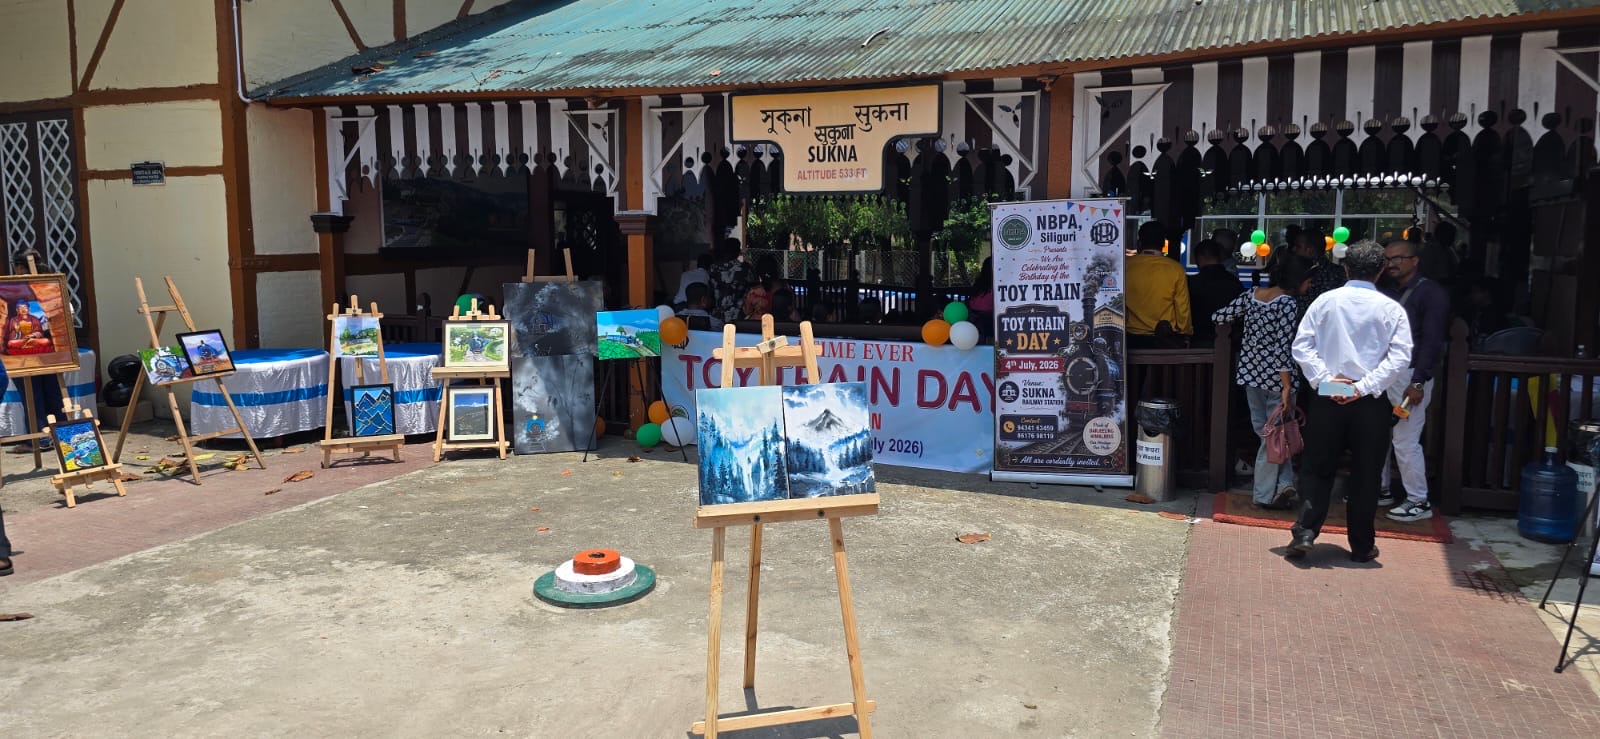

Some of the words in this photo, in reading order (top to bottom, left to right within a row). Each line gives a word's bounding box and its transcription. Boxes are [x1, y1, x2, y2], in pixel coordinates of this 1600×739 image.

[853, 103, 909, 132] सुकना
[808, 145, 858, 163] SUKNA
[797, 169, 837, 180] ALTITUDE
[839, 168, 854, 178] 533
[1036, 214, 1083, 231] NBPA,
[1040, 231, 1076, 244] Siliguri
[1043, 245, 1068, 253] Presents
[1021, 263, 1058, 273] Celebrating
[1059, 262, 1069, 270] the
[1019, 272, 1049, 282] Birthday
[1050, 272, 1059, 282] of
[1059, 271, 1070, 279] the
[998, 284, 1029, 302] TOY
[1032, 283, 1081, 301] TRAIN
[1001, 317, 1030, 331] TOY
[1032, 316, 1066, 330] TRAIN
[1016, 333, 1051, 350] DAY
[816, 341, 856, 359] IME
[863, 343, 914, 362] EVER
[1005, 360, 1017, 369] 4th
[1019, 360, 1037, 371] July,
[1039, 360, 1059, 370] 2026
[1022, 388, 1055, 398] SUKNA
[889, 438, 924, 458] 2026)
[1045, 457, 1075, 467] cordially
